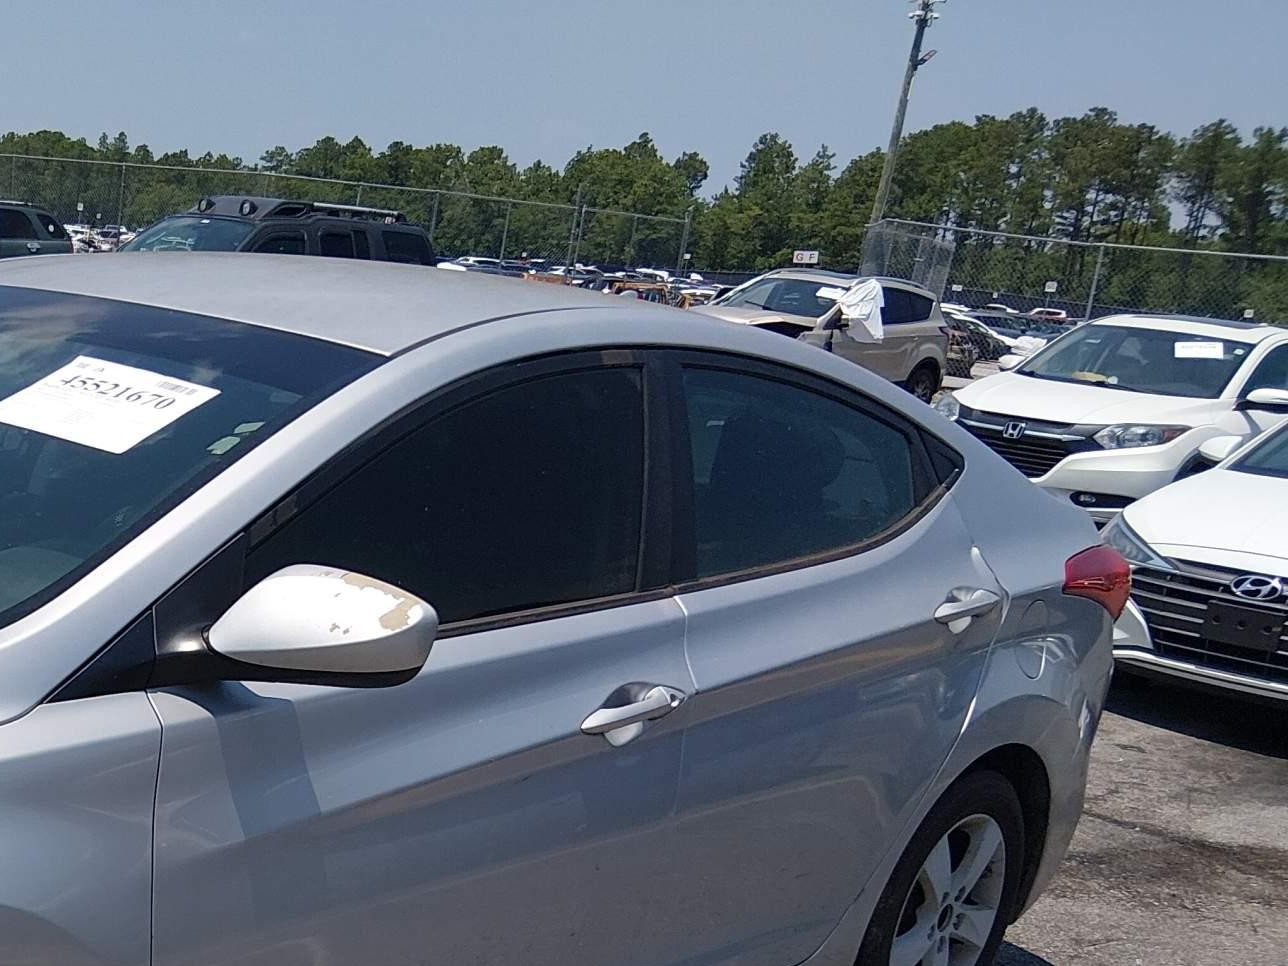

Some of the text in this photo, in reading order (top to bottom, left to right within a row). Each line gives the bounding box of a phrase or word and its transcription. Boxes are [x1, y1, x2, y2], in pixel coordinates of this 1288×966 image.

[796, 253, 816, 262] G F
[60, 375, 176, 410] 45521670
